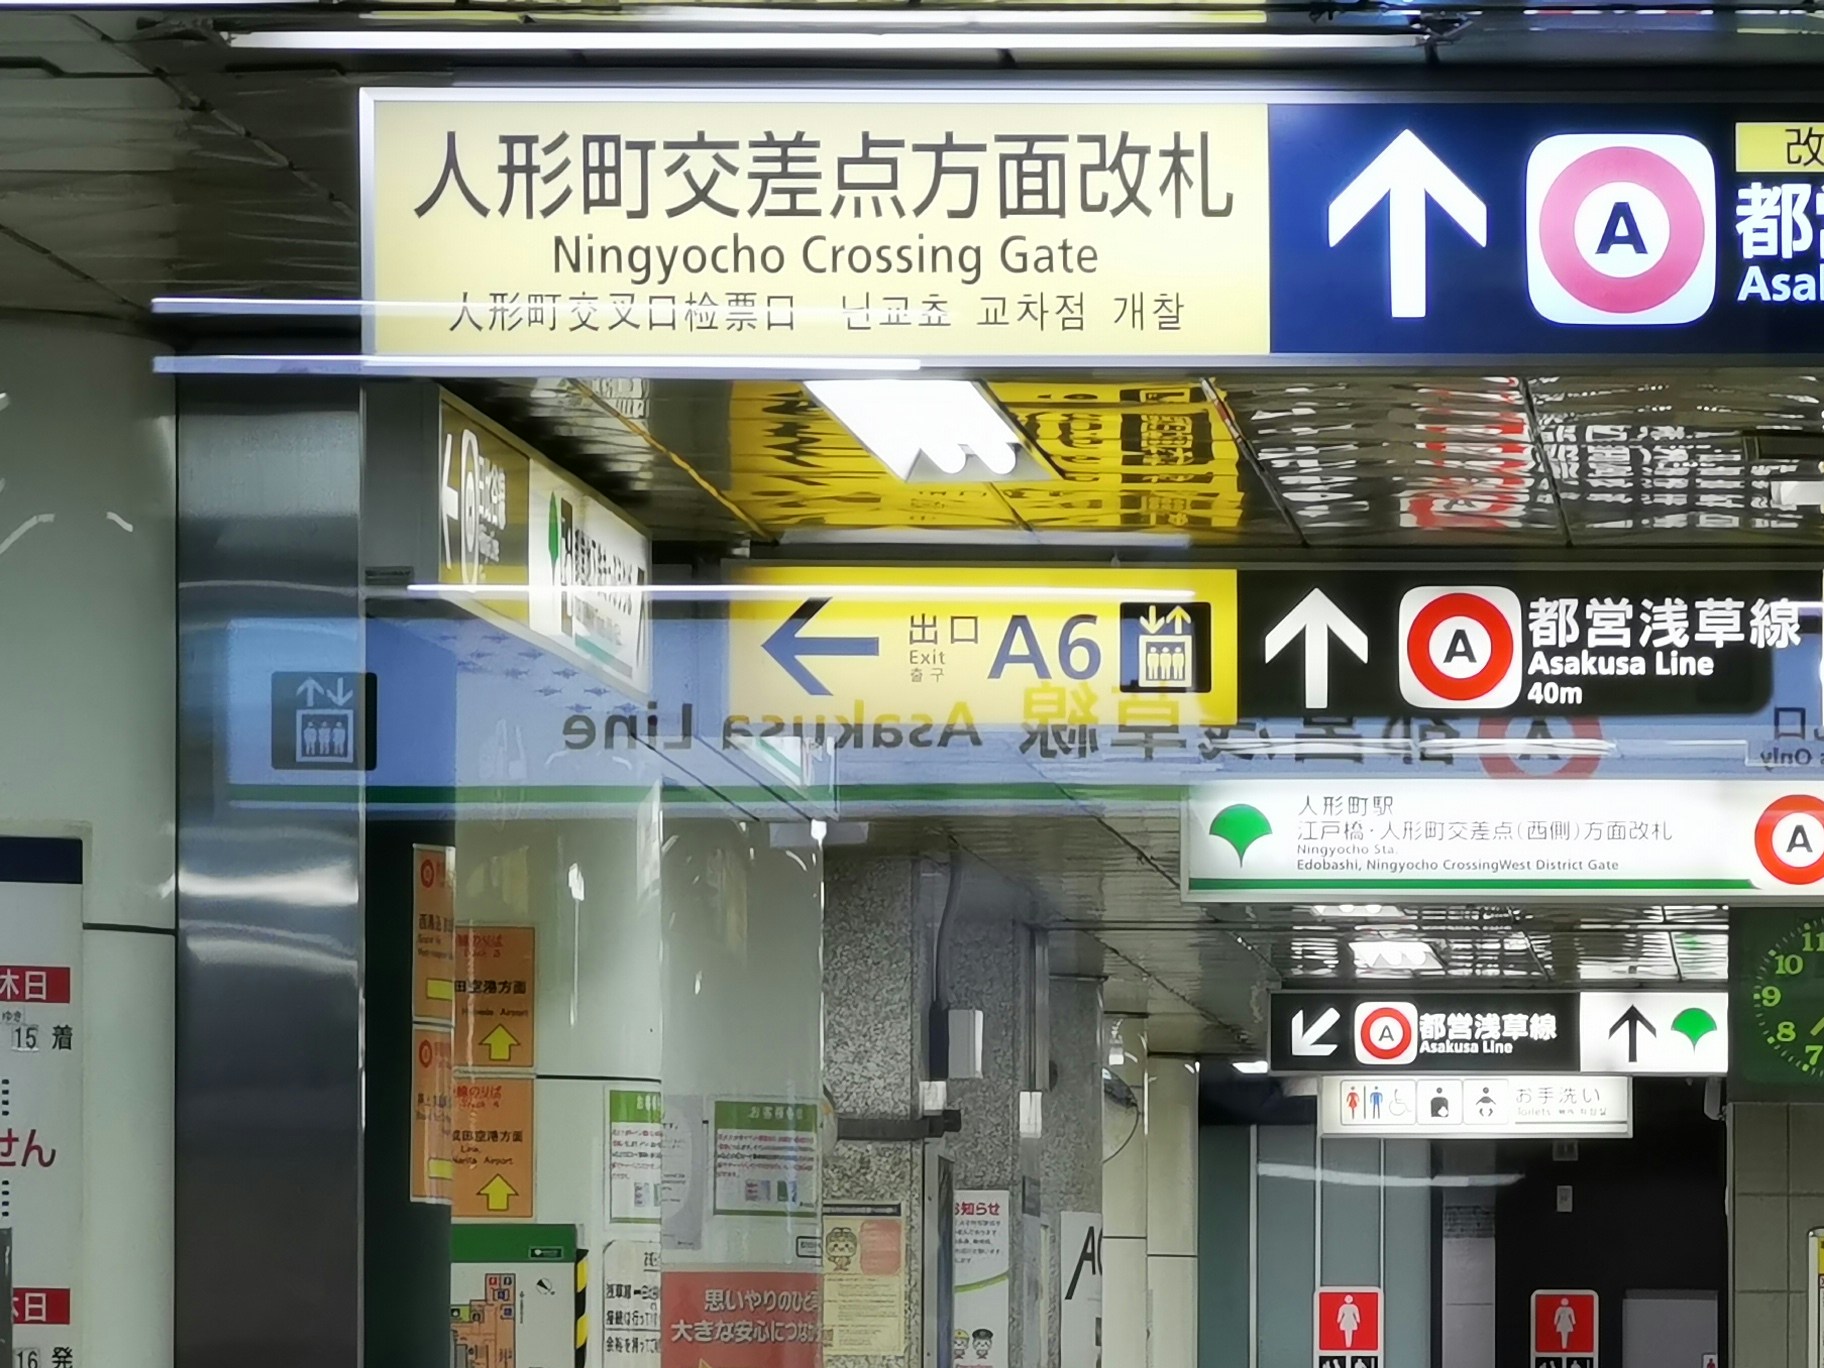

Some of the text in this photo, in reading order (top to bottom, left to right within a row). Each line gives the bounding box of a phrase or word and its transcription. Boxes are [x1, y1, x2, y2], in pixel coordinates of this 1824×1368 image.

[413, 130, 1234, 220] 人形町交差点方面改札
[1595, 202, 1648, 255] A
[554, 235, 1100, 286] Ningyocho Crossing Gate
[976, 291, 1085, 332] 교차점
[1113, 291, 1185, 332] 개찰
[908, 613, 980, 646] 出口
[1527, 599, 1802, 650] 都営浅草線
[909, 649, 947, 666] Exit
[987, 612, 1103, 681] A6
[1442, 629, 1477, 663] A
[1528, 651, 1715, 676] Asakusa Line
[1527, 681, 1583, 705] 40m
[1298, 795, 1394, 817] 人形町駅
[1787, 824, 1813, 853] A
[1297, 845, 1370, 858] Ningyocho
[1297, 859, 1362, 872] Edobashi,
[1366, 859, 1439, 874] Ningyocho
[1536, 859, 1583, 871] District
[1588, 859, 1619, 871] Gate
[1774, 954, 1803, 975] 10
[1761, 987, 1782, 1008] 9
[15, 1024, 73, 1050] 15 着
[1378, 1025, 1395, 1042] A
[1419, 1012, 1558, 1041] 都営浅草線
[1776, 1021, 1797, 1043] 8
[1420, 1041, 1513, 1054] Asakusa Line
[1804, 1046, 1824, 1067] 7
[1515, 1086, 1600, 1105] お手洗い
[1065, 1225, 1103, 1301] A
